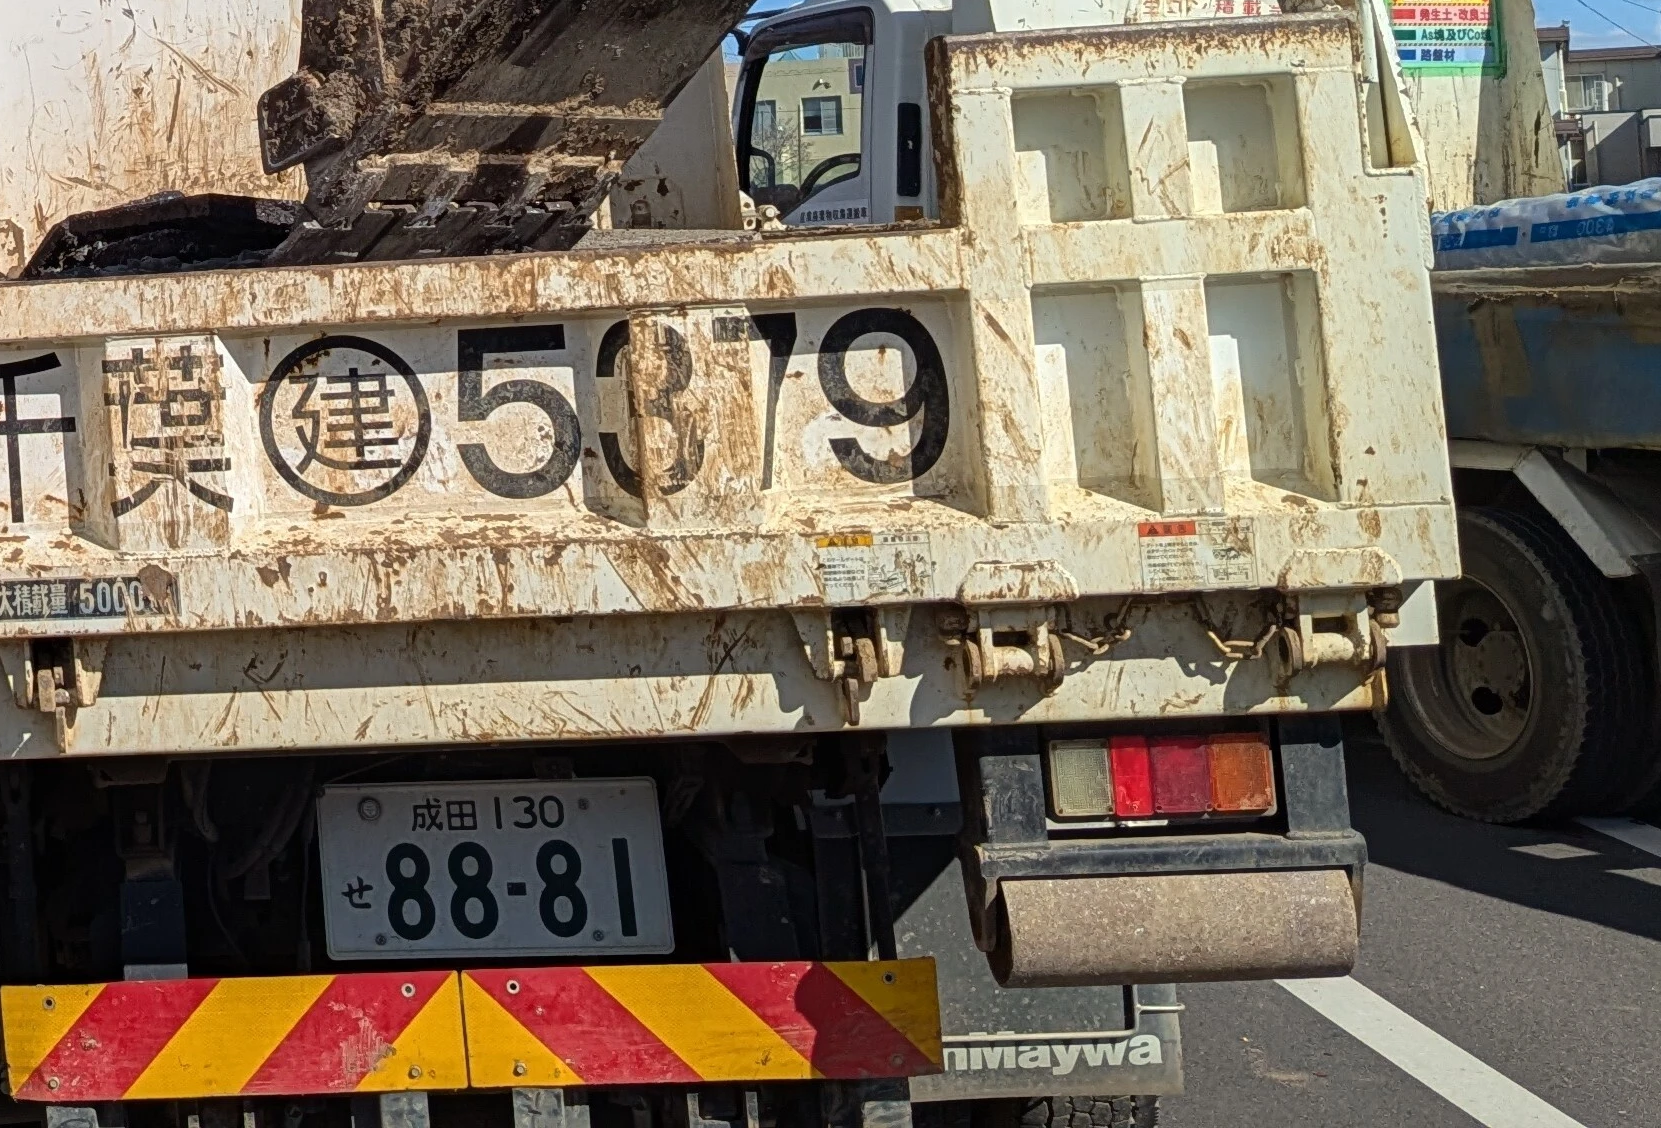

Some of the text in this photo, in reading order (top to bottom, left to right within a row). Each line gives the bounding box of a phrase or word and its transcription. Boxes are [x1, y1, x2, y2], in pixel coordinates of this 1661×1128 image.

[1421, 48, 1456, 61] 路盤材
[457, 307, 950, 500] 5379
[411, 795, 565, 832] 成田 130
[341, 837, 638, 941] せ 88-81
